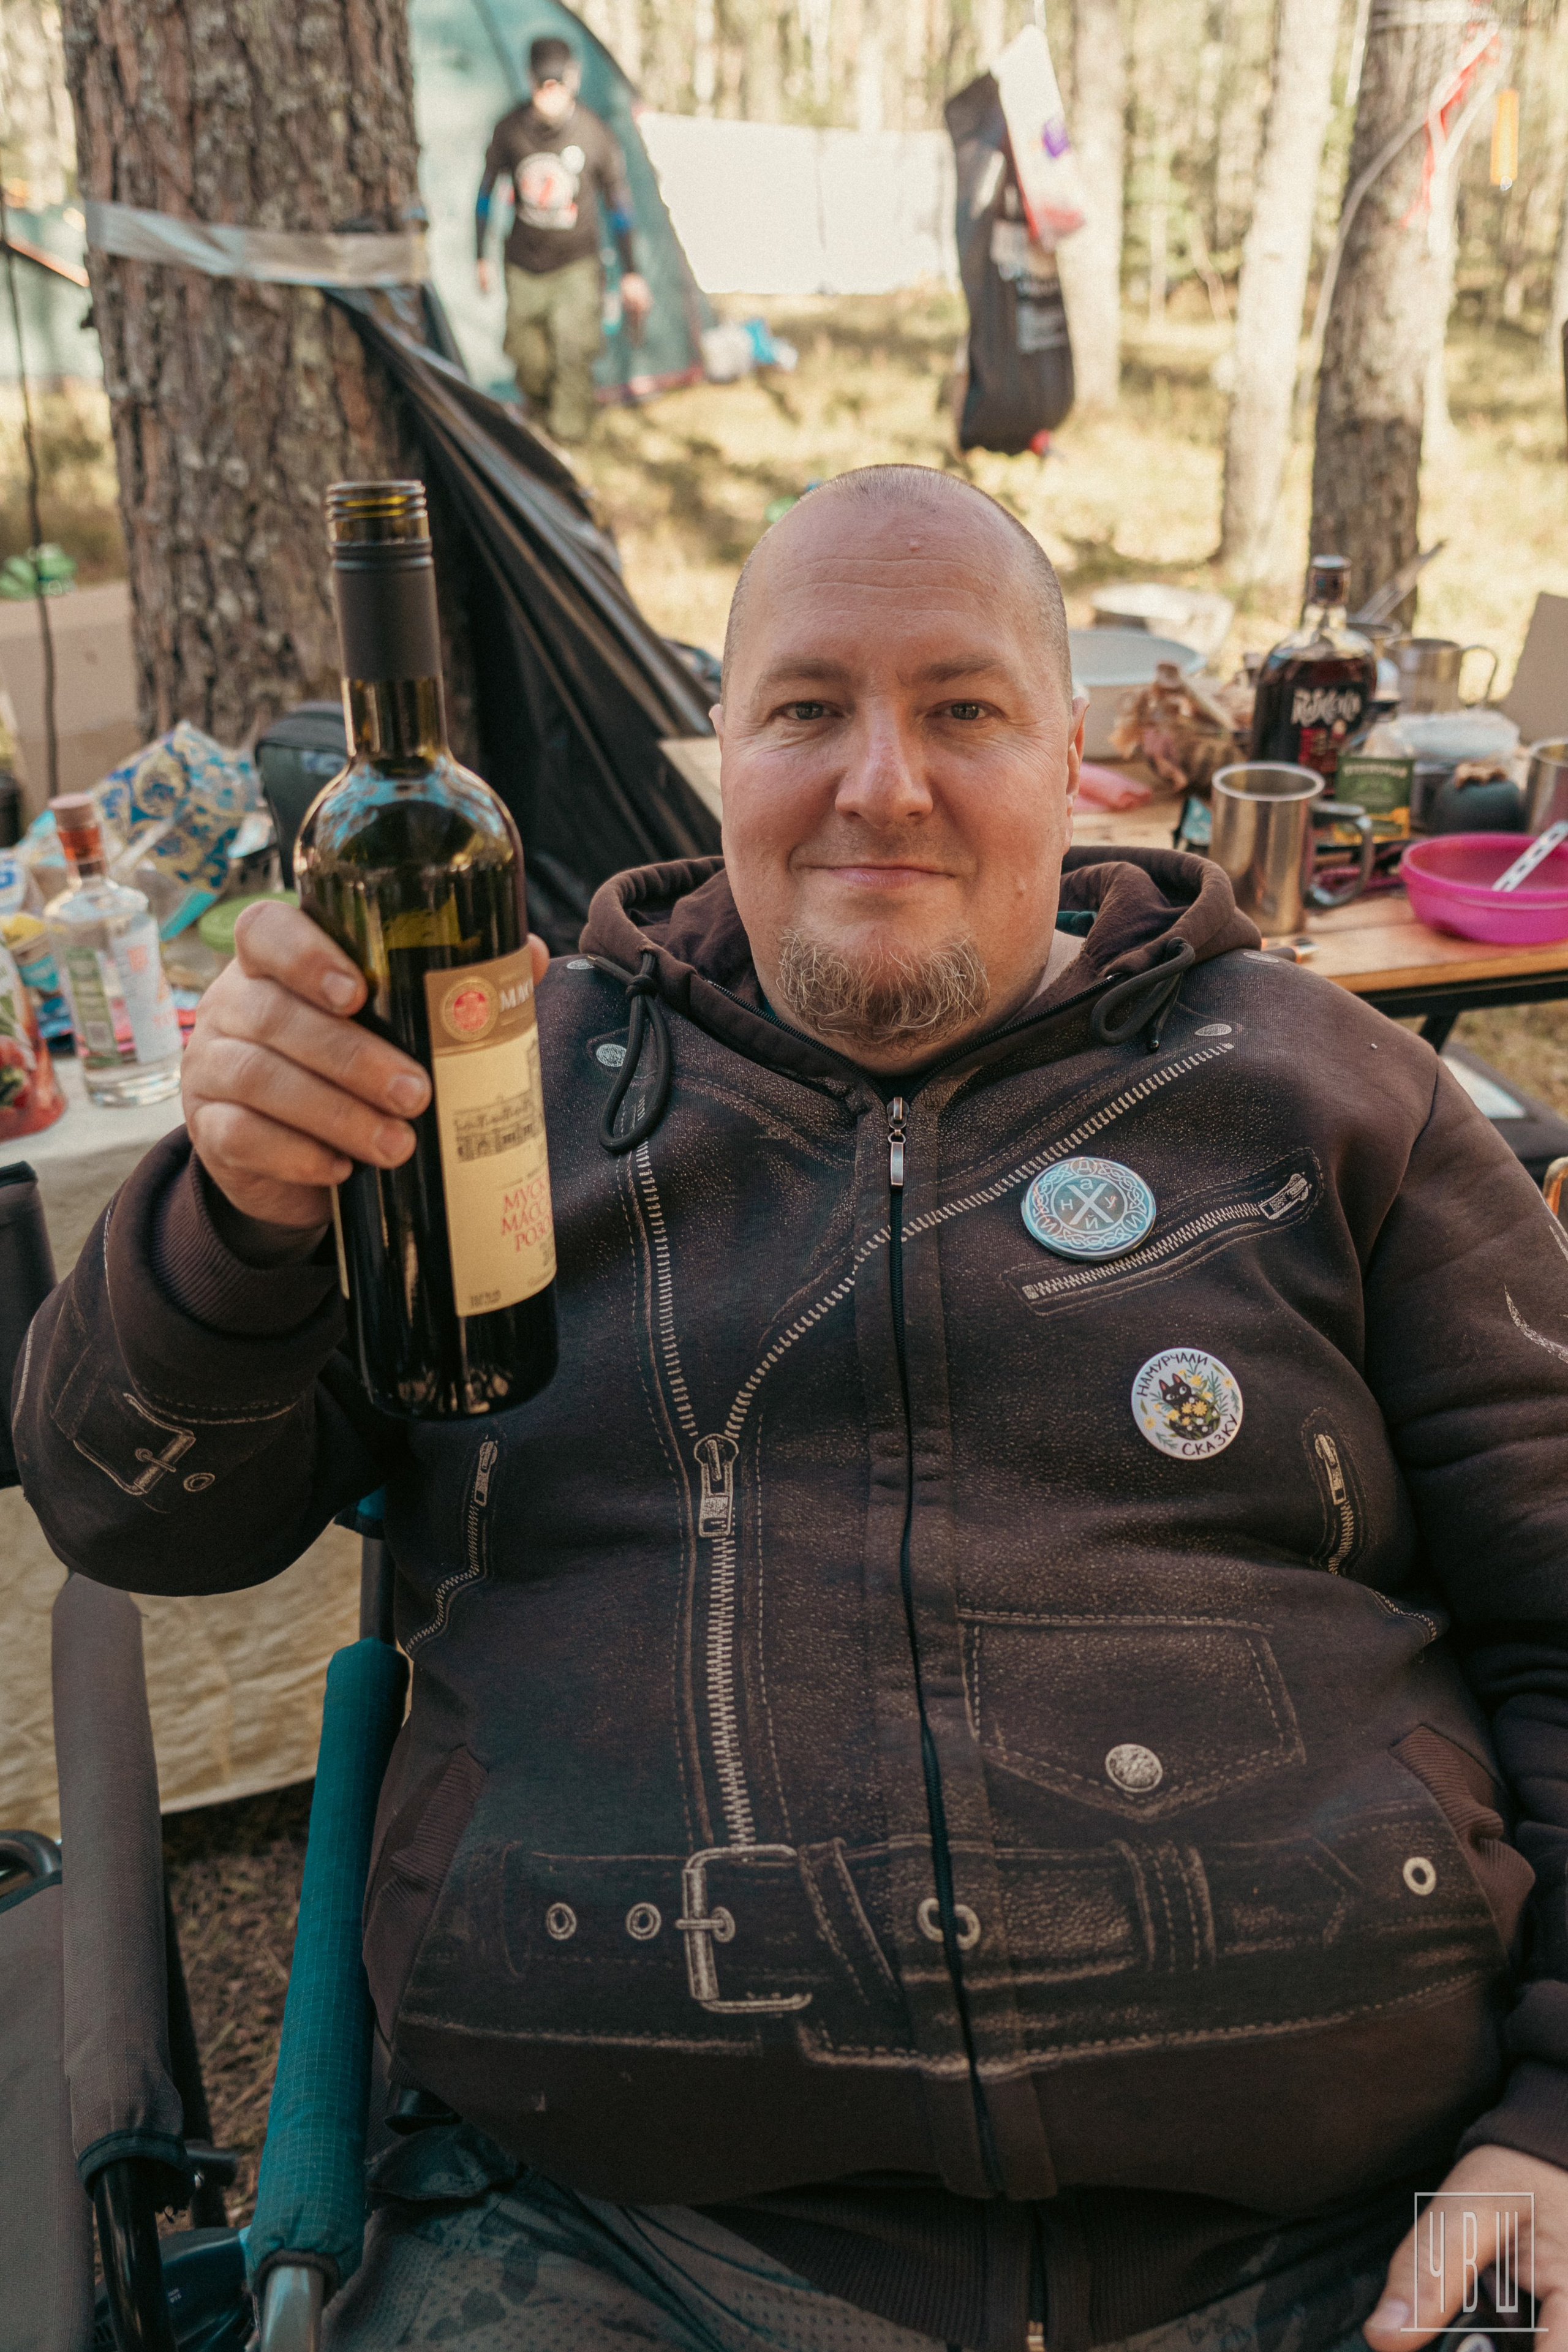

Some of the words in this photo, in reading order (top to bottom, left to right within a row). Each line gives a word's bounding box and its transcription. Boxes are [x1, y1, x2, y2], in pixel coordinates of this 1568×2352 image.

[1077, 1160, 1092, 1174] Д
[1136, 1352, 1208, 1396] НАМУРЧАЛИ
[1182, 1414, 1238, 1456] СКАЗКУ
